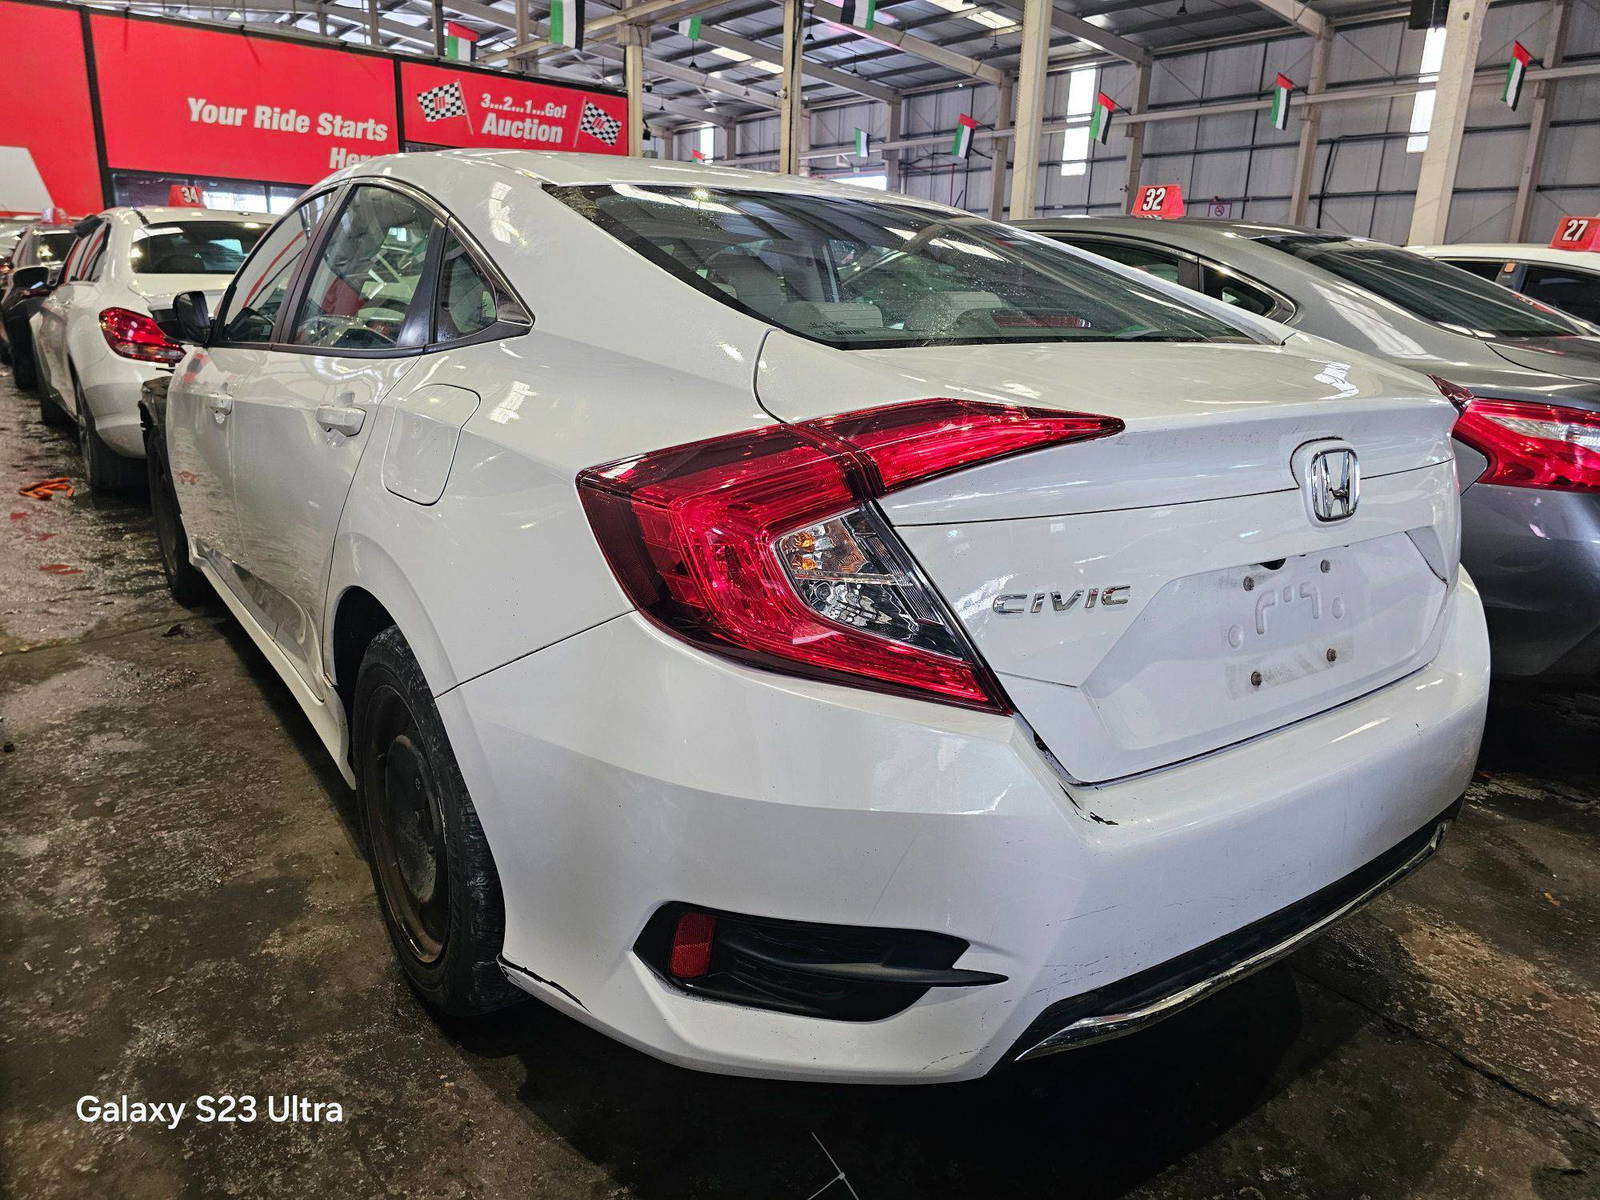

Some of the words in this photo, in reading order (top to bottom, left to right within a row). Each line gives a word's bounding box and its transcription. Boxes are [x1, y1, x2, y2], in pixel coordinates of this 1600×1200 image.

[187, 97, 247, 127] Your
[254, 105, 310, 133] Ride
[316, 113, 389, 142] Starts
[481, 112, 563, 143] Auction
[180, 187, 199, 203] 34
[1142, 187, 1166, 211] 32
[1562, 219, 1589, 241] 27
[992, 585, 1131, 614] CIVIC
